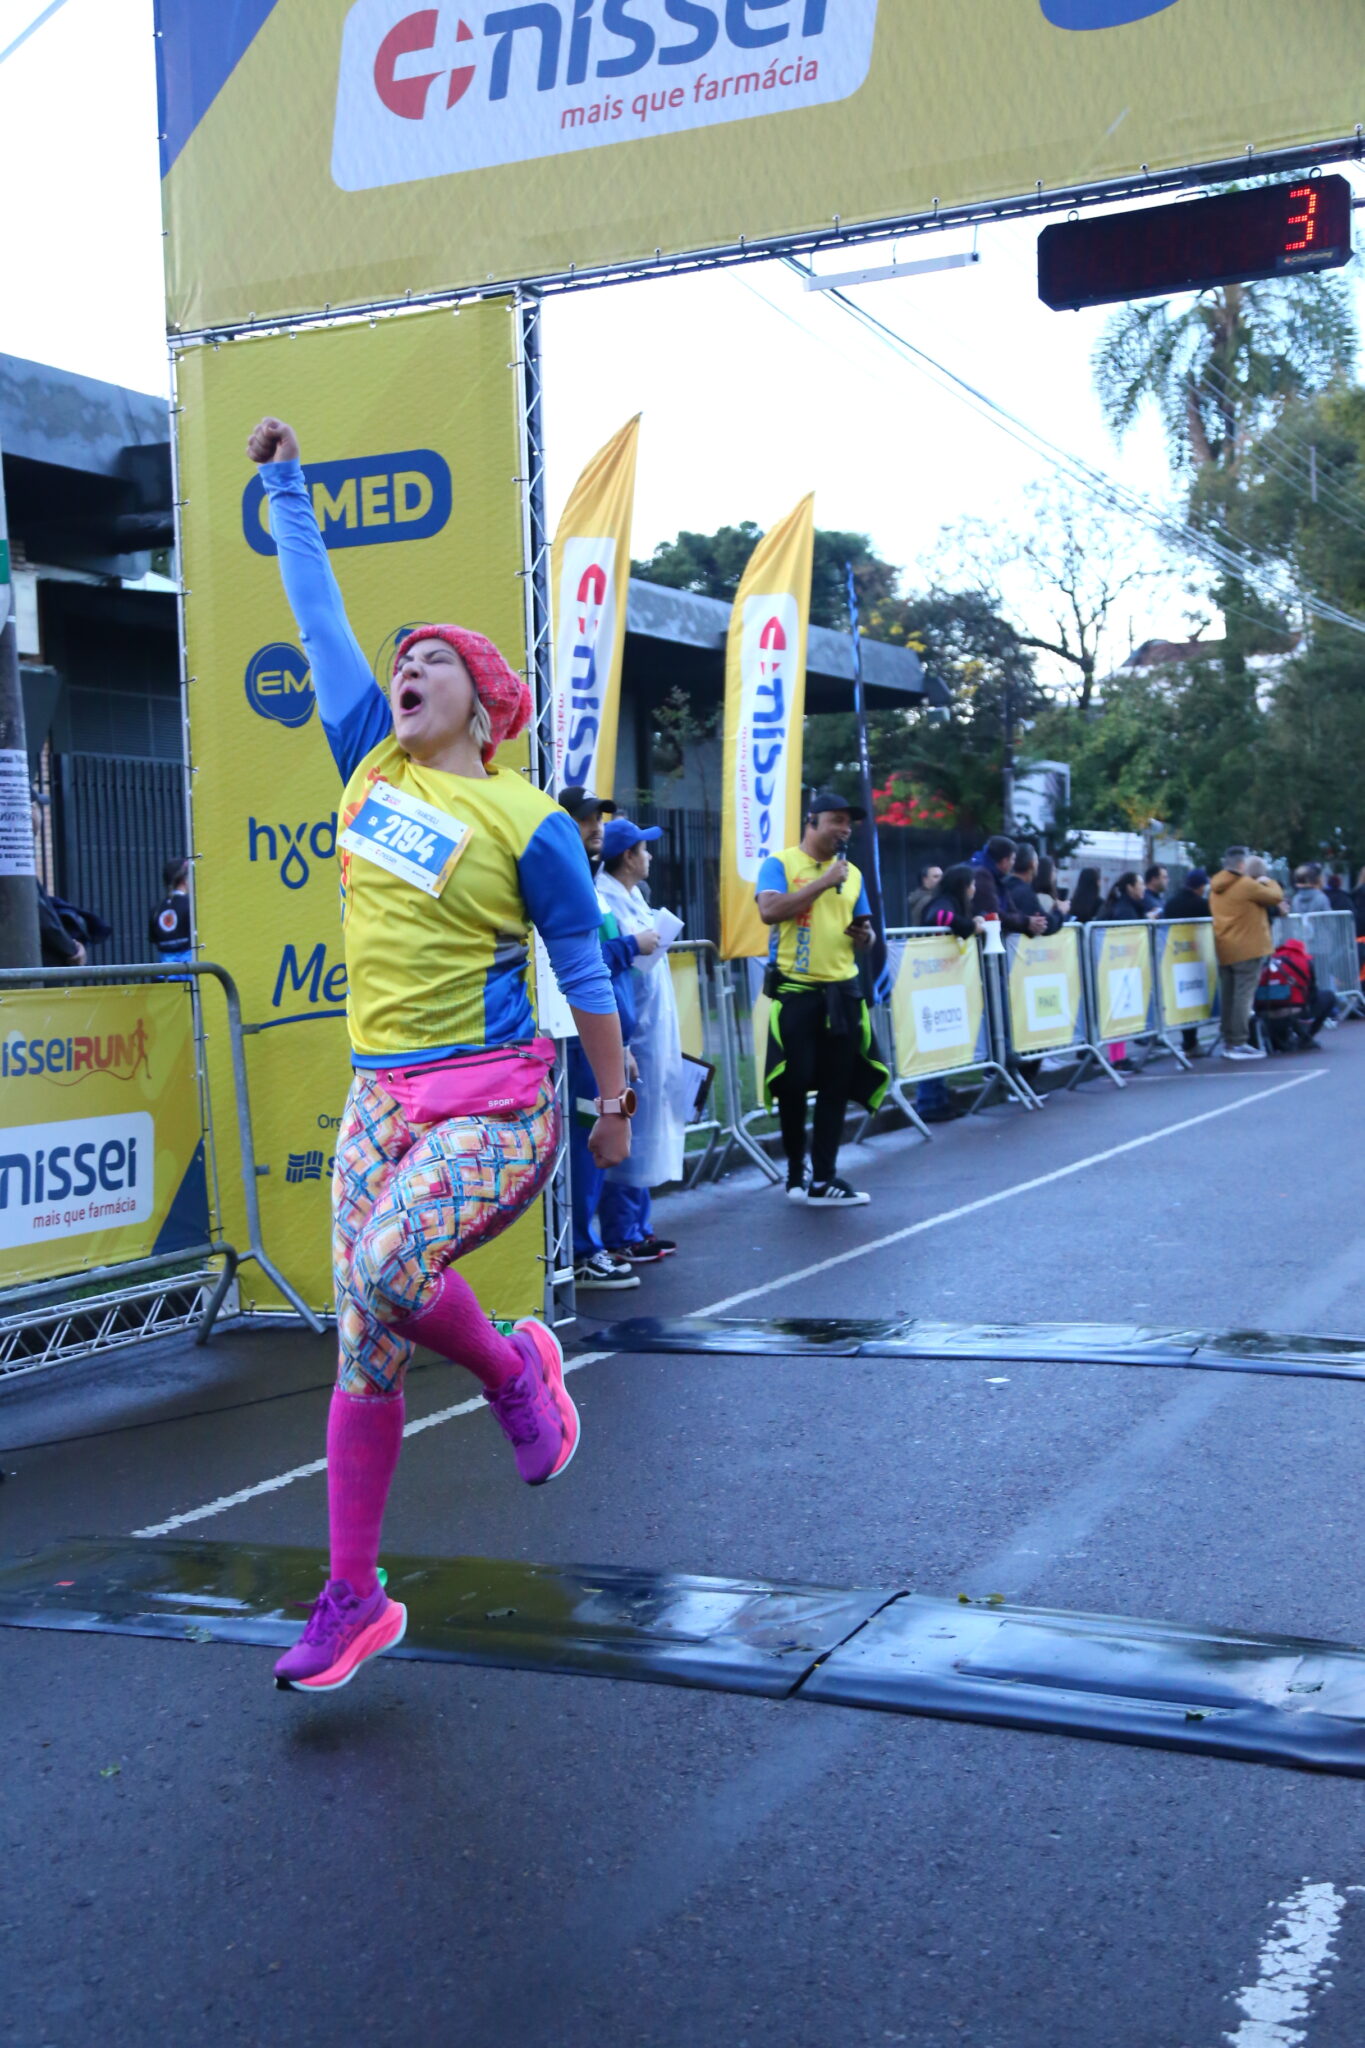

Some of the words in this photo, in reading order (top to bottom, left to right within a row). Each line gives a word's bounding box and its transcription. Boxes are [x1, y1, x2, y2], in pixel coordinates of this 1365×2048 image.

[560, 95, 624, 129] mais
[631, 87, 685, 122] que
[693, 56, 819, 103] farmácia
[1285, 188, 1317, 250] 3
[373, 814, 438, 864] 2194
[487, 1097, 515, 1107] SPORT
[32, 1209, 61, 1229] mais
[63, 1207, 85, 1228] que
[88, 1197, 136, 1219] farmácia
